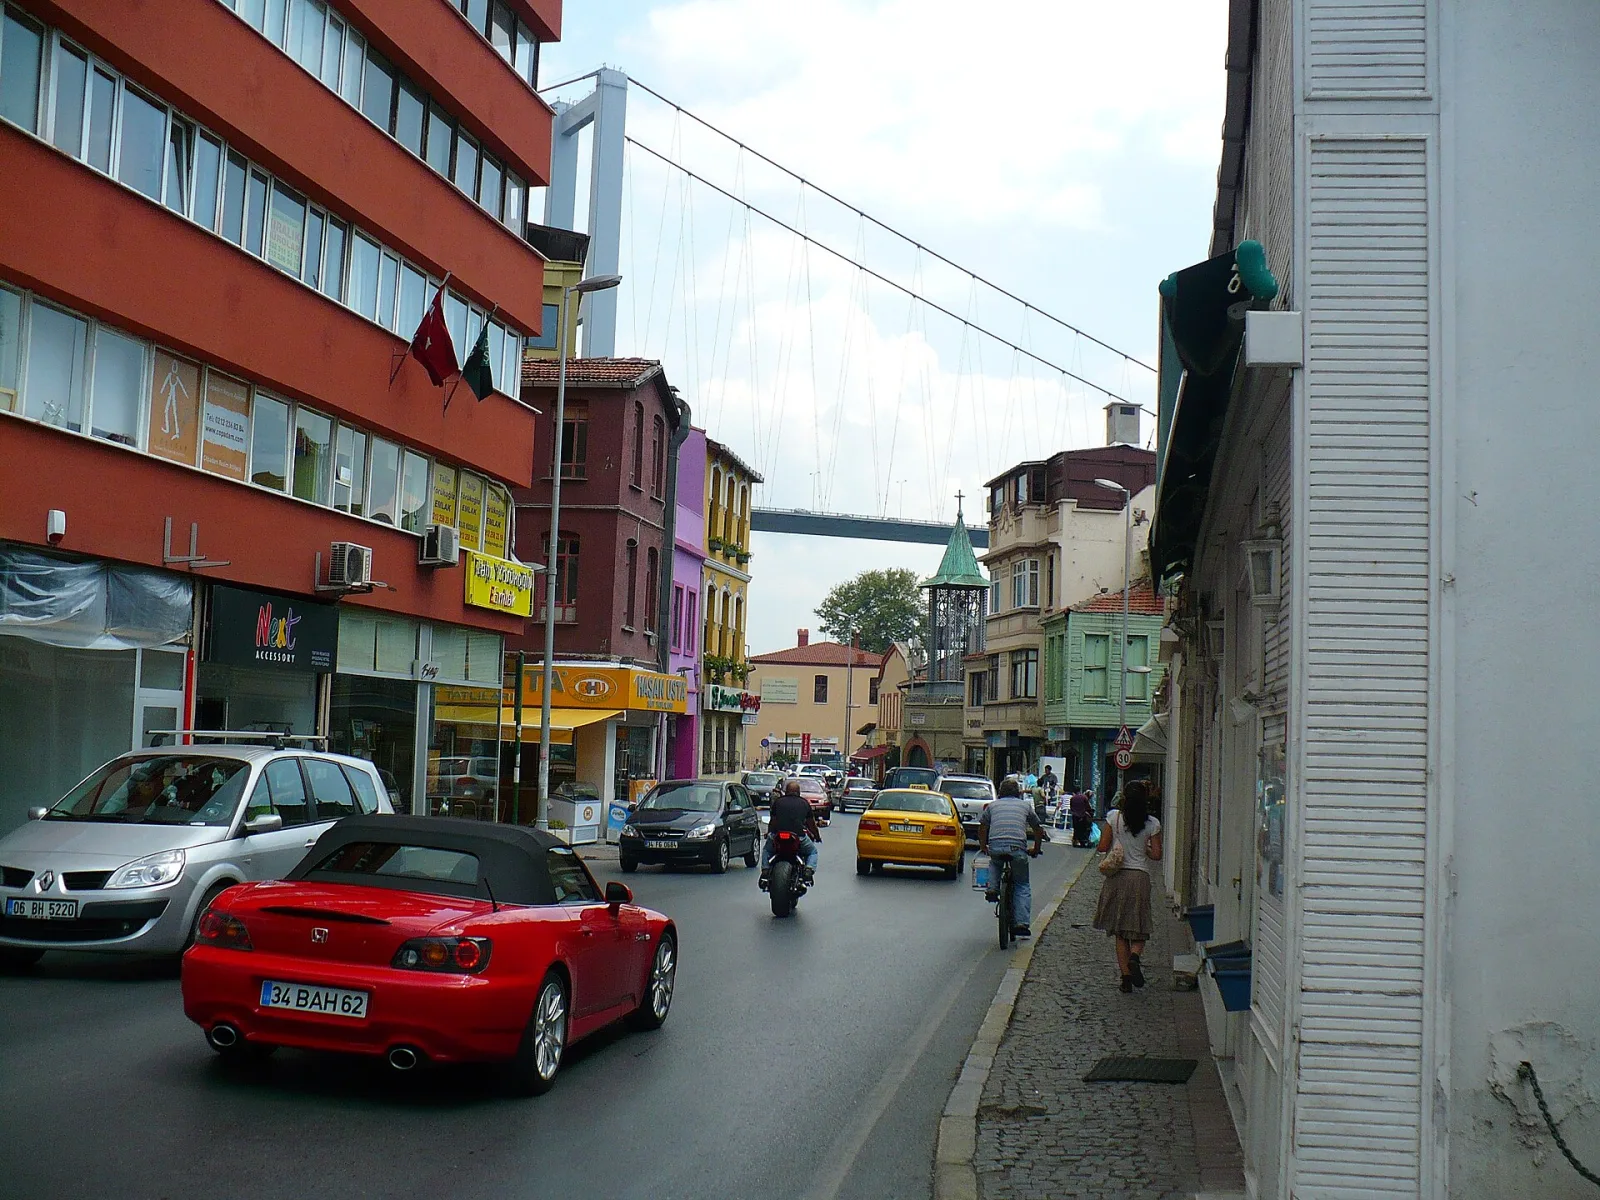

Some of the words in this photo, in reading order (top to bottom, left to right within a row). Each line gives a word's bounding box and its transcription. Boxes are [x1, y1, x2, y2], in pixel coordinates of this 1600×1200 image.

[434, 500, 451, 512] EMLAK
[462, 504, 477, 516] EMLAK
[256, 602, 301, 651] Next
[255, 650, 295, 663] ACCESSORY
[666, 679, 686, 702] USTA
[1118, 753, 1129, 764] 30
[13, 901, 26, 914] 06
[31, 901, 44, 915] BH
[49, 902, 74, 917] 5220
[271, 985, 291, 1006] 34
[296, 988, 338, 1012] BAH
[341, 994, 364, 1015] 62
